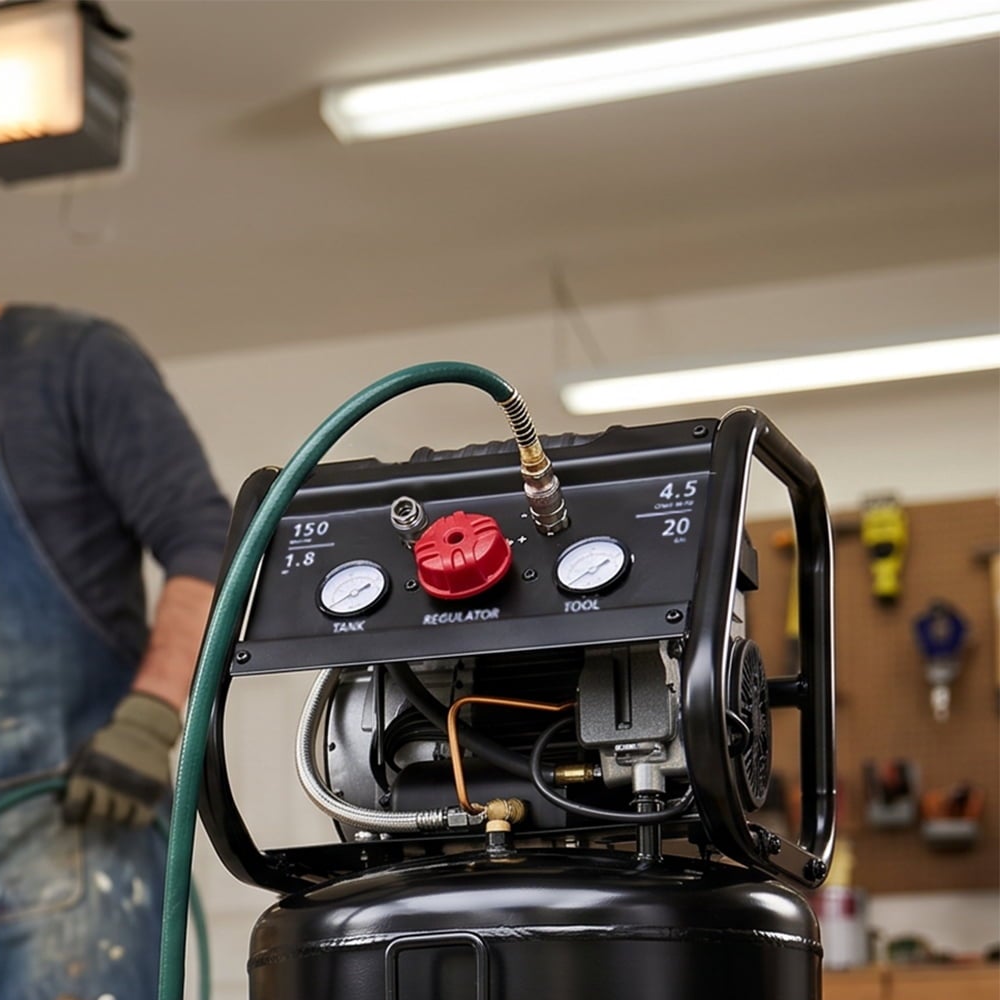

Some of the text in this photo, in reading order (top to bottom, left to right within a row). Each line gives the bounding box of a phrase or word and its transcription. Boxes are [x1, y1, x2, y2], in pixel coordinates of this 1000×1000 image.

[660, 480, 698, 499] 4.5
[294, 521, 329, 537] 150
[662, 517, 690, 536] 20
[286, 552, 315, 567] 1.8
[564, 599, 600, 613] TOOL
[422, 608, 500, 625] REGULATOR
[333, 620, 366, 633] TANK
